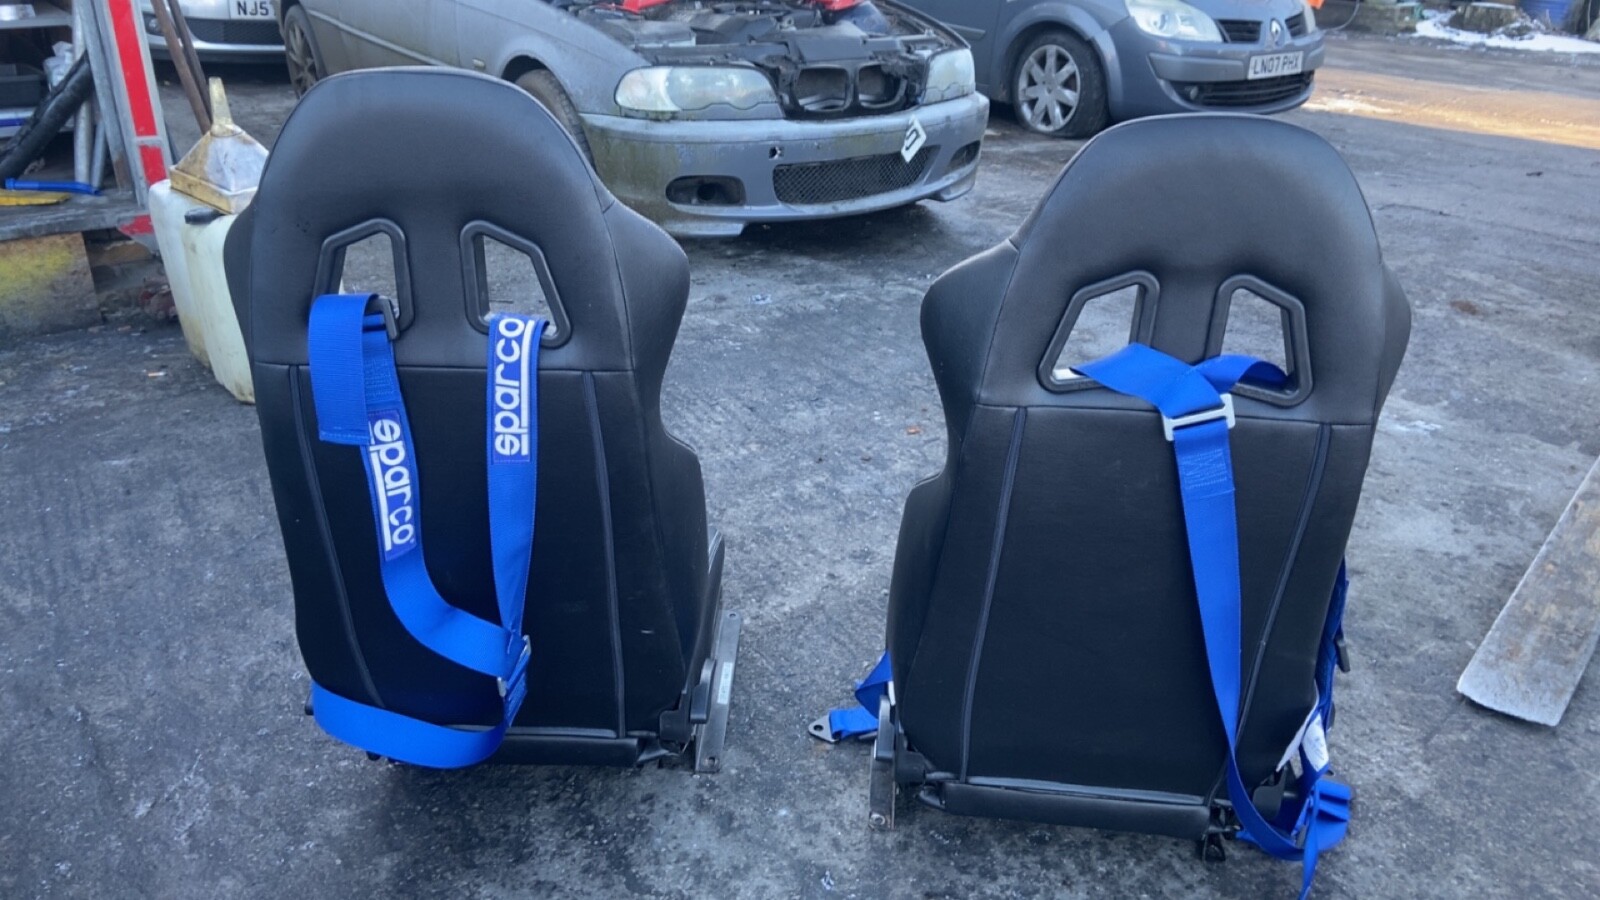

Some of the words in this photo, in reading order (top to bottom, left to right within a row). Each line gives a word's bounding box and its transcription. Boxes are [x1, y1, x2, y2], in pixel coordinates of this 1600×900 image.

[236, 0, 277, 16] NJ5
[1253, 56, 1281, 75] LN07
[494, 317, 532, 456] sparco
[369, 418, 415, 548] sparco
